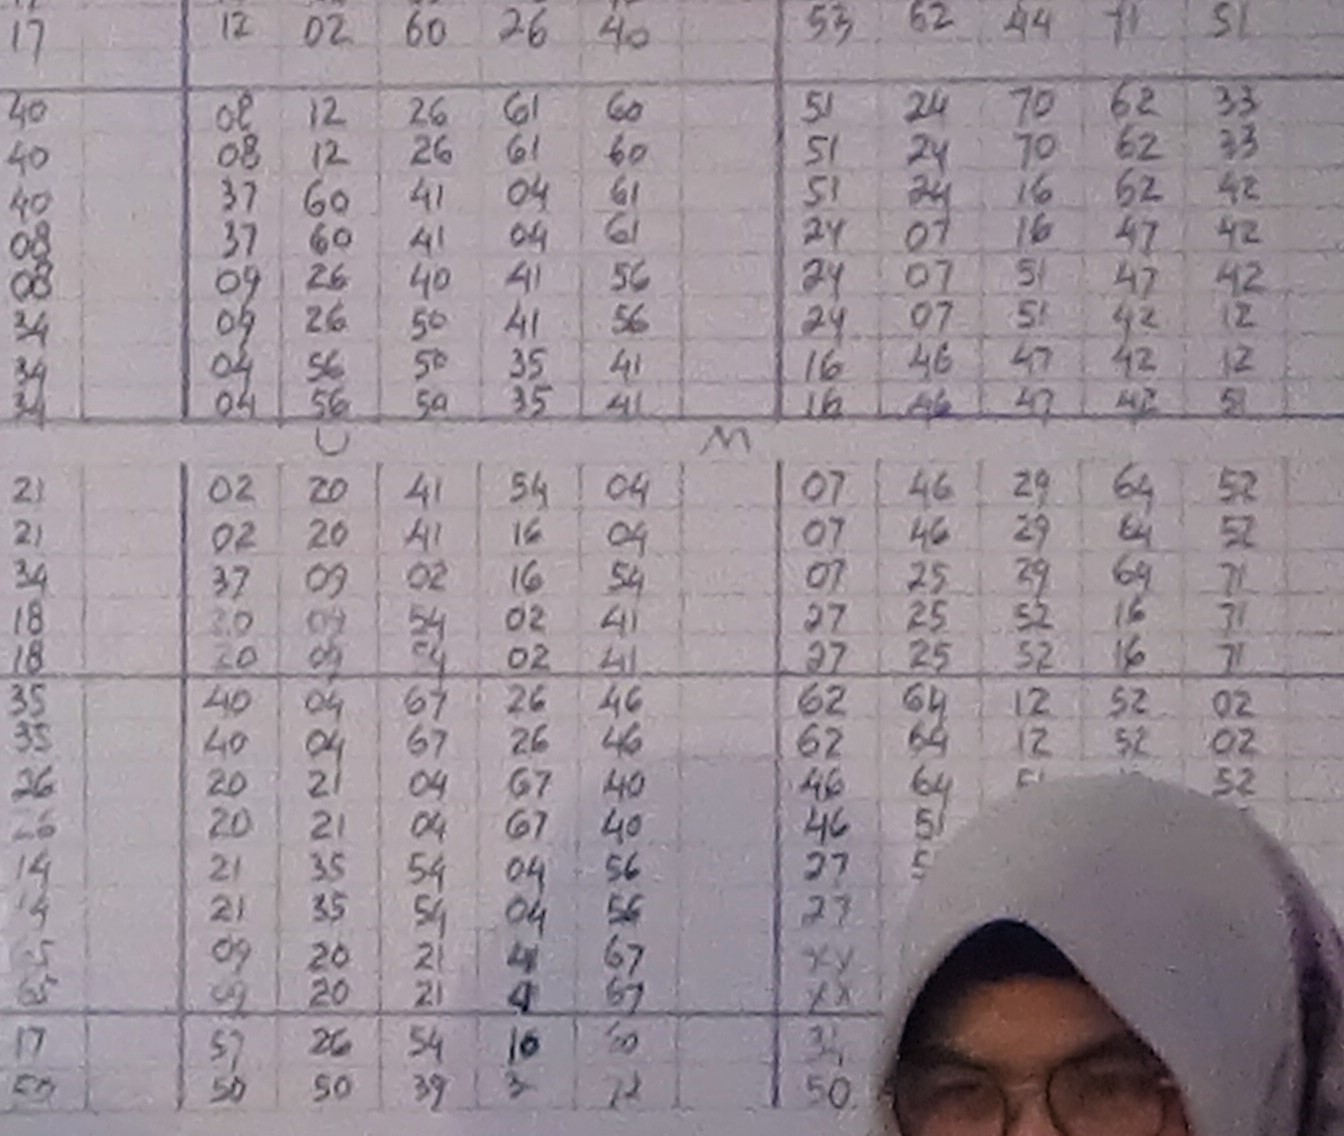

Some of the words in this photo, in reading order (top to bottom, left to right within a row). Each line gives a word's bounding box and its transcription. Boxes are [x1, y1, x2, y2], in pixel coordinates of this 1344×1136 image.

[222, 12, 252, 39] 12
[305, 15, 354, 47] 02
[406, 15, 446, 46] 60
[598, 16, 649, 49] 40
[11, 145, 48, 170] 40
[219, 136, 260, 166] 08
[312, 139, 350, 166] 12
[412, 136, 452, 165] 26
[507, 136, 537, 163] 61
[806, 136, 835, 163] 51
[1017, 132, 1056, 160] 70
[1116, 130, 1162, 161] 62
[223, 221, 257, 258] 37
[310, 221, 351, 249] 60
[411, 226, 442, 258] 41
[606, 218, 638, 244] 61
[906, 223, 950, 248] 07
[1018, 220, 1051, 246] 16
[1116, 220, 1157, 250] 47
[1216, 218, 1262, 246] 42
[316, 428, 349, 456] U
[701, 424, 750, 454] M
[12, 477, 42, 503] 21
[211, 475, 255, 502] 02
[311, 477, 347, 503] 20
[406, 478, 440, 504] 41
[512, 473, 547, 507] 54
[606, 473, 649, 503] 04
[802, 472, 845, 498] 07
[910, 473, 952, 499] 46
[1014, 472, 1048, 507] 29
[1112, 464, 1153, 502] 64
[1218, 470, 1257, 502] 52
[214, 566, 249, 597] 37
[407, 561, 448, 590] 02
[512, 561, 543, 590] 16
[611, 561, 643, 590] 54
[807, 565, 845, 589] 07
[909, 562, 950, 591] 25
[1016, 562, 1048, 599] 29
[1220, 564, 1244, 591] 71
[12, 684, 45, 715] 35
[204, 691, 250, 712] 40
[405, 691, 447, 717] 67
[508, 690, 545, 713] 26
[598, 688, 642, 712] 46
[799, 686, 845, 715] 62
[1017, 689, 1049, 713] 12
[1112, 689, 1149, 714] 52
[1213, 691, 1252, 715] 02
[309, 770, 339, 795] 21
[412, 771, 448, 798] 04
[508, 768, 550, 797] 67
[603, 771, 644, 798] 40
[211, 854, 241, 882] 21
